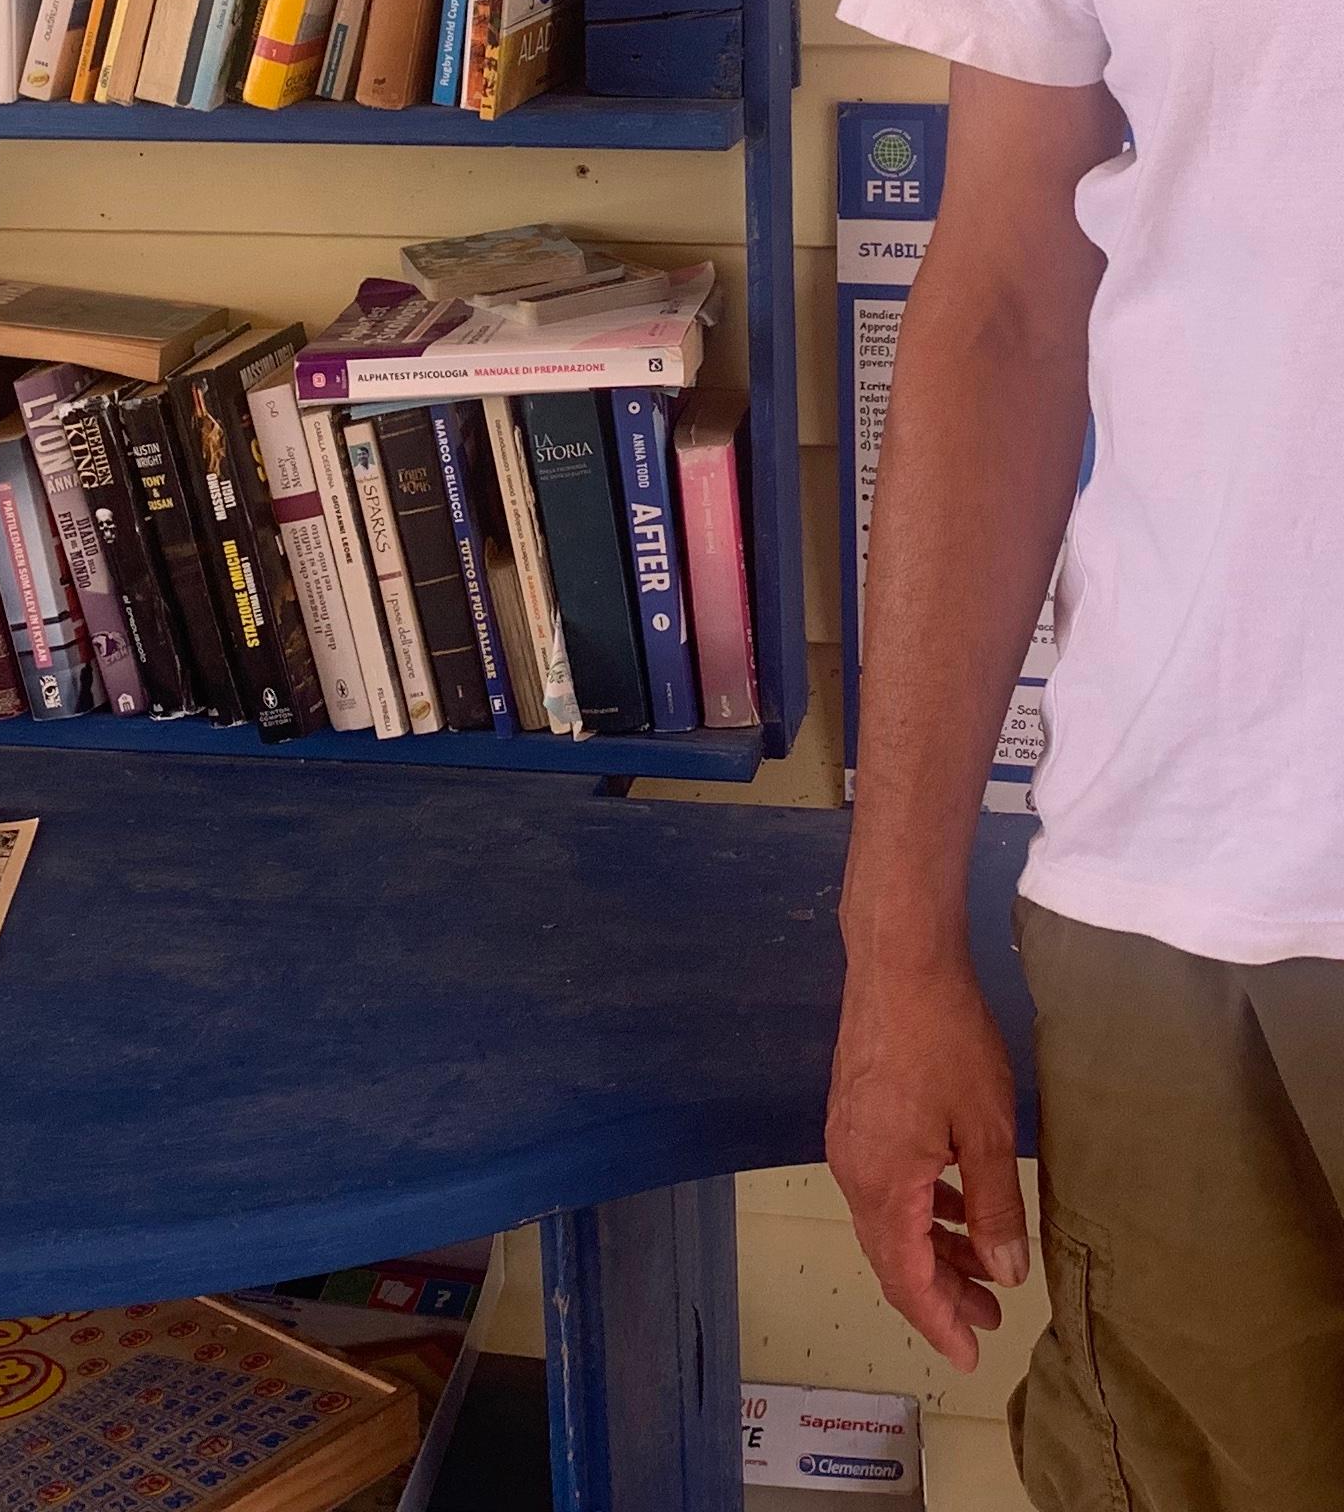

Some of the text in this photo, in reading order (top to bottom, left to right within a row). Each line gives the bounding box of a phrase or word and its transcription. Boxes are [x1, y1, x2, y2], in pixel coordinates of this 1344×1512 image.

[443, 21, 460, 53] World
[436, 53, 457, 86] Rugby
[866, 180, 920, 203] FEE
[357, 363, 606, 383] ALPHATEST PSICOLOGIA MANUALE DI PREPARAZIONE
[64, 422, 98, 489] KING
[83, 417, 114, 487] STEPHEN
[535, 434, 552, 449] LA
[536, 442, 594, 464] STORIA
[433, 419, 464, 524] MARCO CELLUCCI
[632, 433, 650, 488] ANNA TODD
[631, 502, 672, 593] AFTER
[799, 1415, 905, 1435] Sapientino
[818, 1459, 896, 1478] Clementoni
